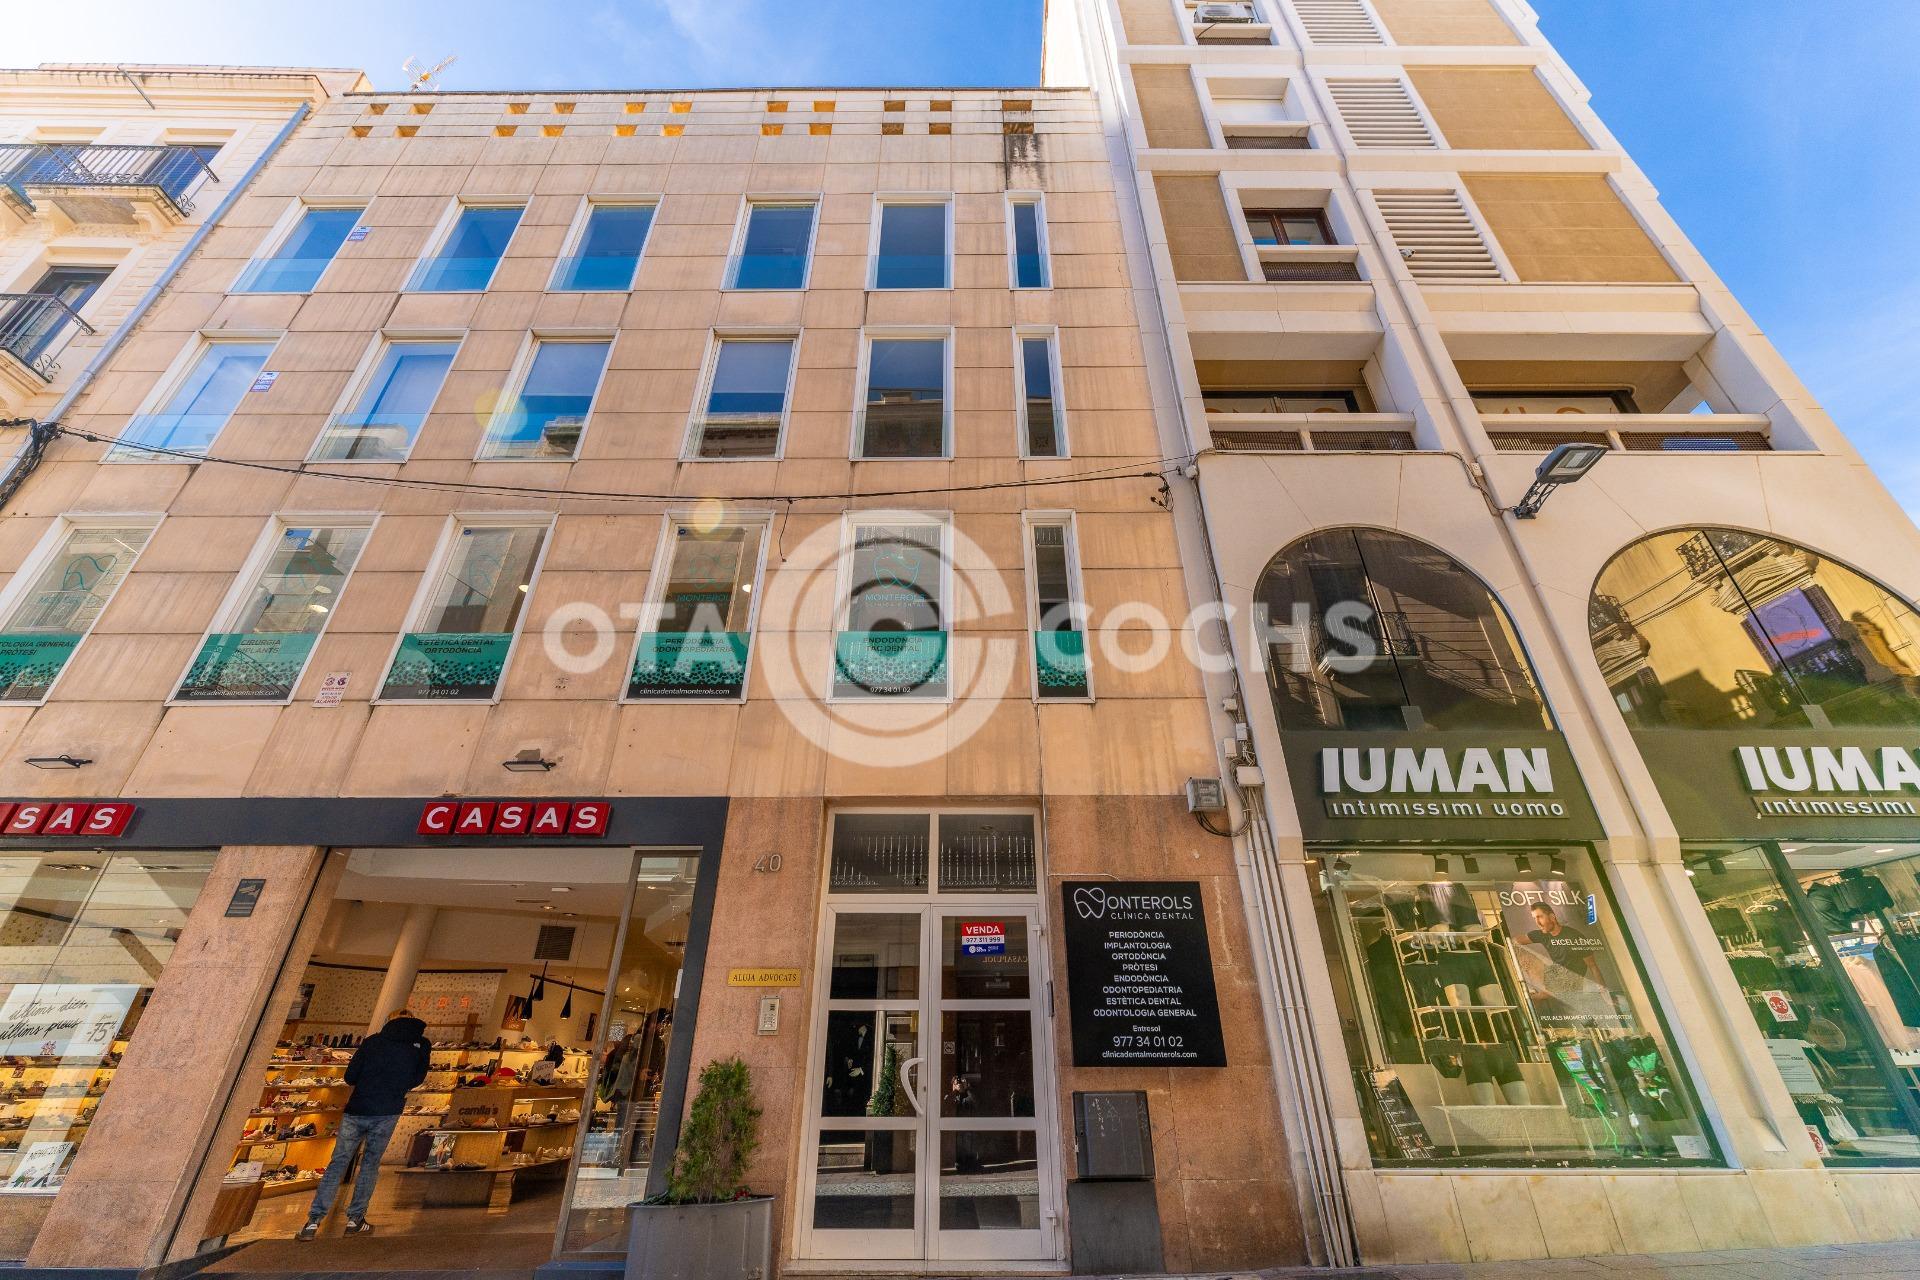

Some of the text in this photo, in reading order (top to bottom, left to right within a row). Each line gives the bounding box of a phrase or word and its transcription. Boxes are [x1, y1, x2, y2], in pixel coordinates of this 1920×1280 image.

[640, 687, 730, 695] clinicadentalmonterols.com
[1322, 747, 1554, 793] IUMAN
[1332, 799, 1564, 816] intimissimi uomo
[1763, 798, 1916, 814] intimissimi
[426, 806, 598, 829] CASAS
[754, 854, 782, 872] 40
[1499, 890, 1586, 906] SOFT SILK
[1110, 911, 1194, 920] CLÍNICA DENTAL
[965, 925, 1001, 934] VENDA
[1109, 930, 1165, 939] PERIODÒNCIA
[1111, 951, 1167, 960] ORTODÒNCIA
[1122, 962, 1158, 971] PRÒTESI
[732, 973, 797, 982] ALUJA ADVOCATS
[1113, 973, 1169, 982] ENDODÒNCIA
[1102, 986, 1183, 994] ODONTOPEDIATRIA
[1106, 995, 1182, 1005] ESTÈTICA DENTAL
[1093, 1008, 1197, 1017] ODONTOLOGIA GENERAL
[1113, 1036, 1184, 1048] 977 34 01 02
[1101, 1050, 1198, 1059] clinicadentalmonterols.com
